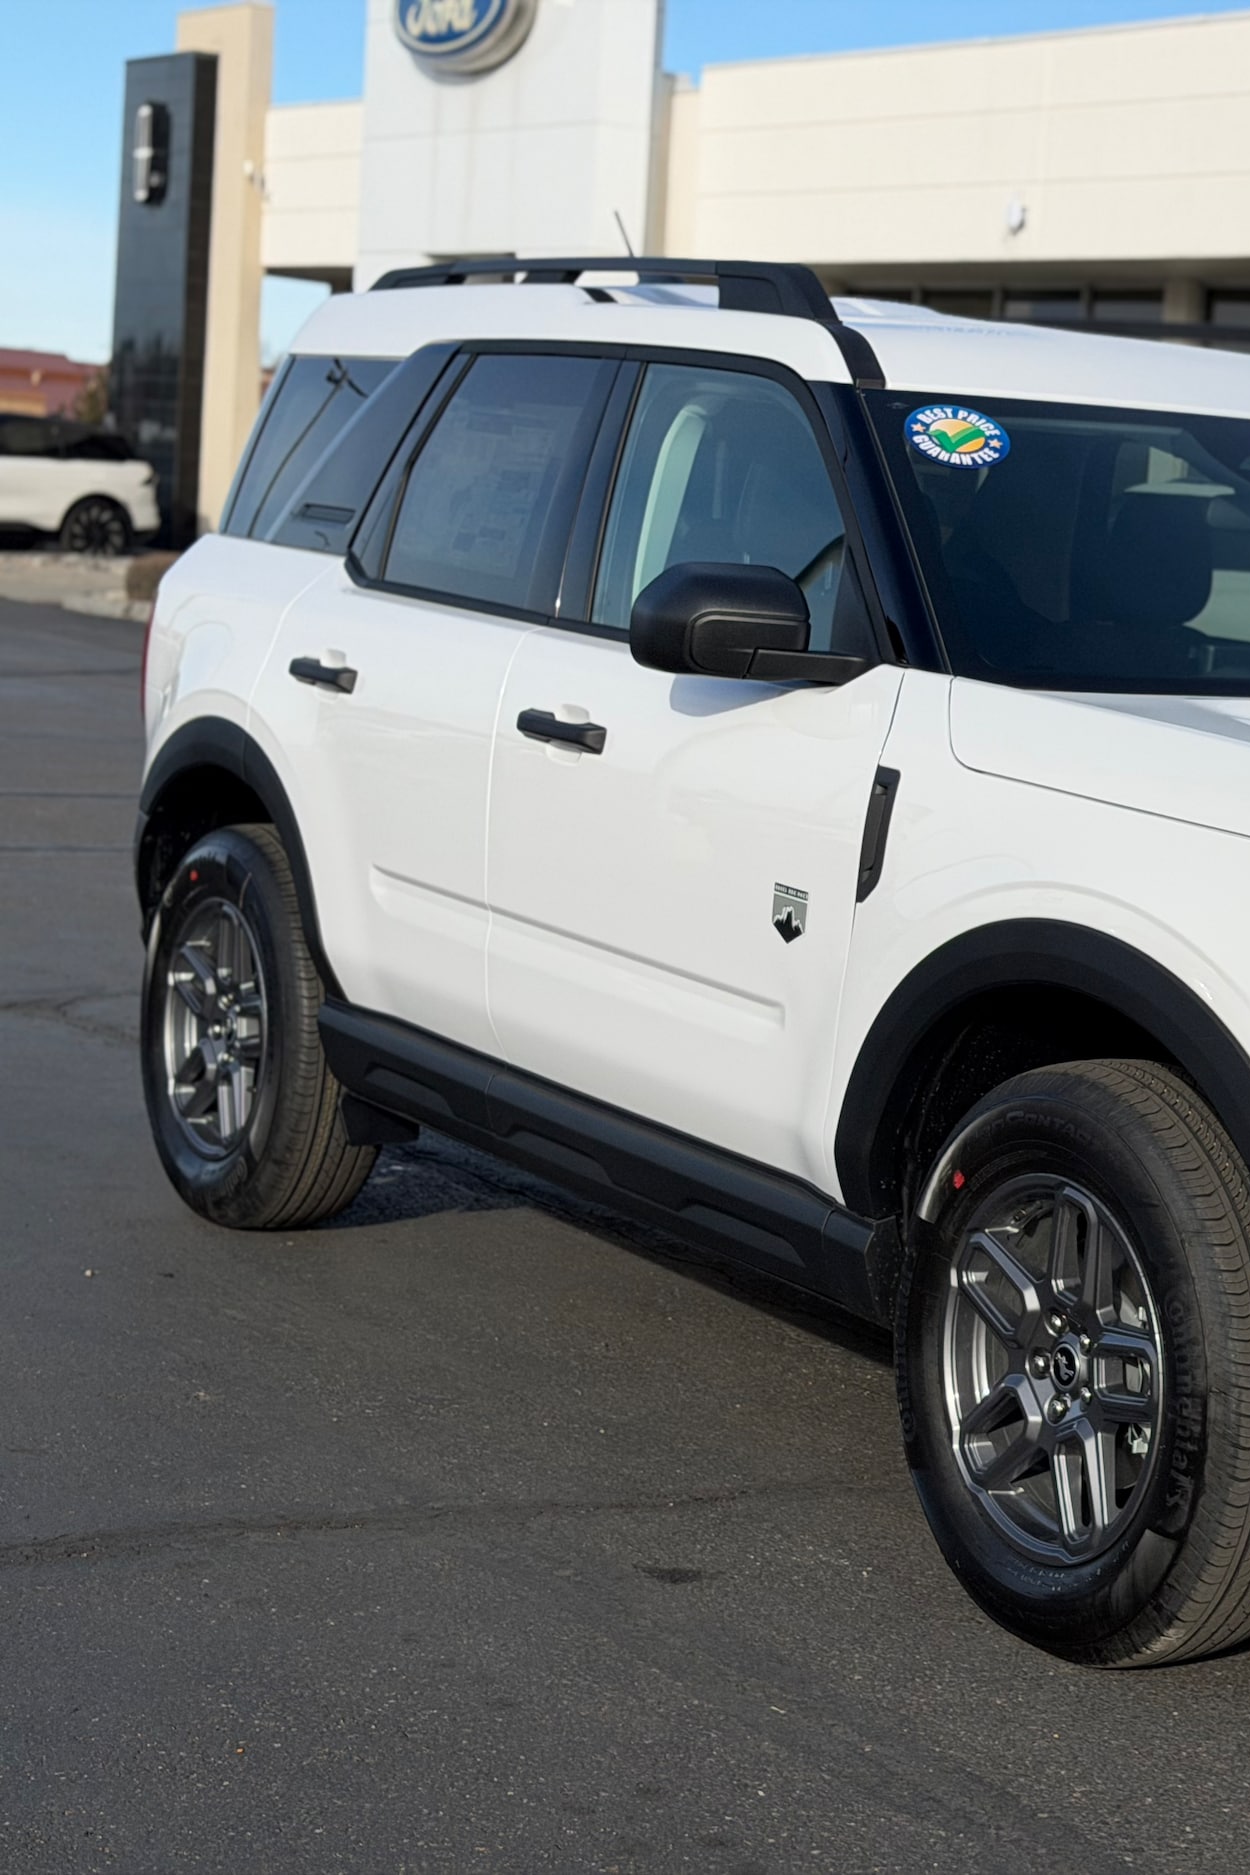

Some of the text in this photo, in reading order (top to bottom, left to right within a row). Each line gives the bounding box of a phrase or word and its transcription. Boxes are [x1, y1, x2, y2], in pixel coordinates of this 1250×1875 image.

[916, 407, 1001, 437] BEST PRICE
[912, 434, 1000, 466] GUARANTEE
